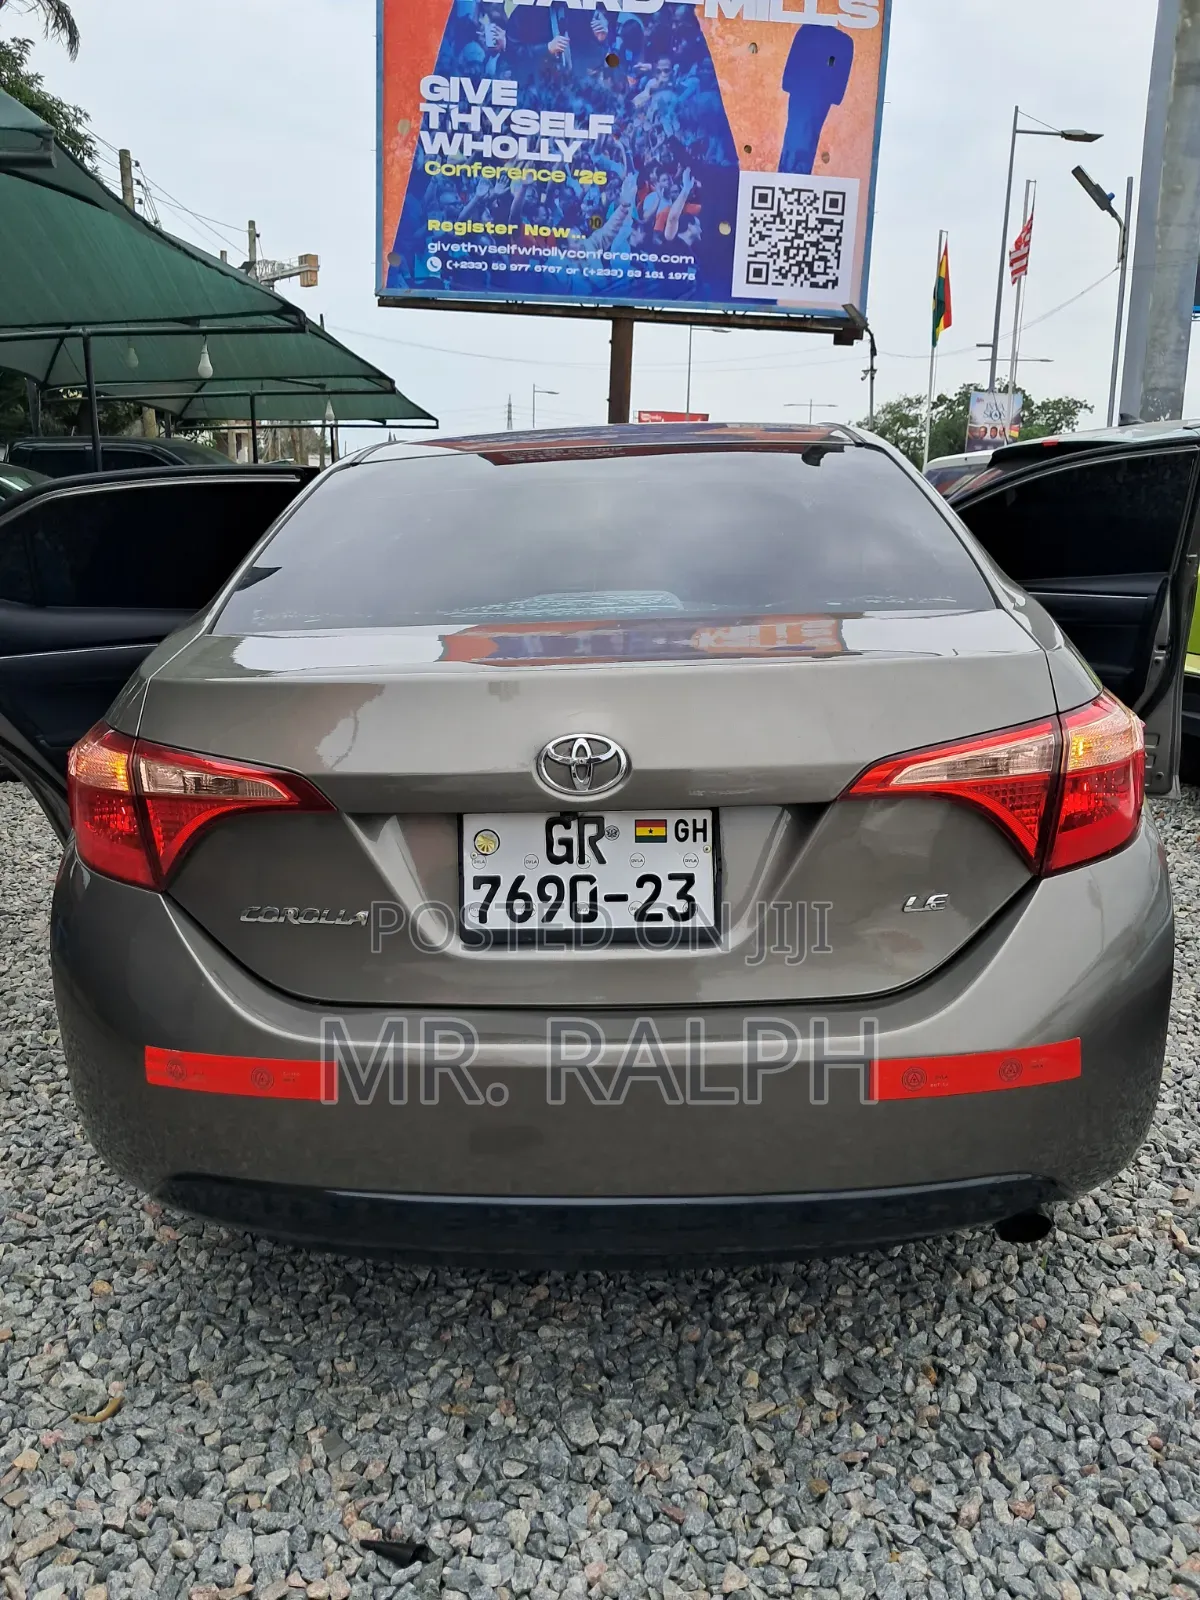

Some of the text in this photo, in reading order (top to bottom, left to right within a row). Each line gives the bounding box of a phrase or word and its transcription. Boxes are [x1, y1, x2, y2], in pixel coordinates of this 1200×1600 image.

[420, 75, 518, 106] GIVE
[420, 103, 614, 139] THYSELF
[420, 131, 582, 163] WHOLLY
[424, 161, 566, 183] Conference
[427, 219, 586, 239] Register Now...
[427, 241, 695, 264] givethyselfwhollyconference.com
[446, 260, 488, 271] (+233)
[510, 263, 531, 272] 977
[566, 266, 580, 275] or
[583, 267, 624, 278] (+233)
[545, 816, 607, 865] GR
[674, 818, 708, 843] GH
[472, 872, 696, 924] 7690-23
[902, 893, 949, 913] LE
[240, 906, 370, 926] COROLLA
